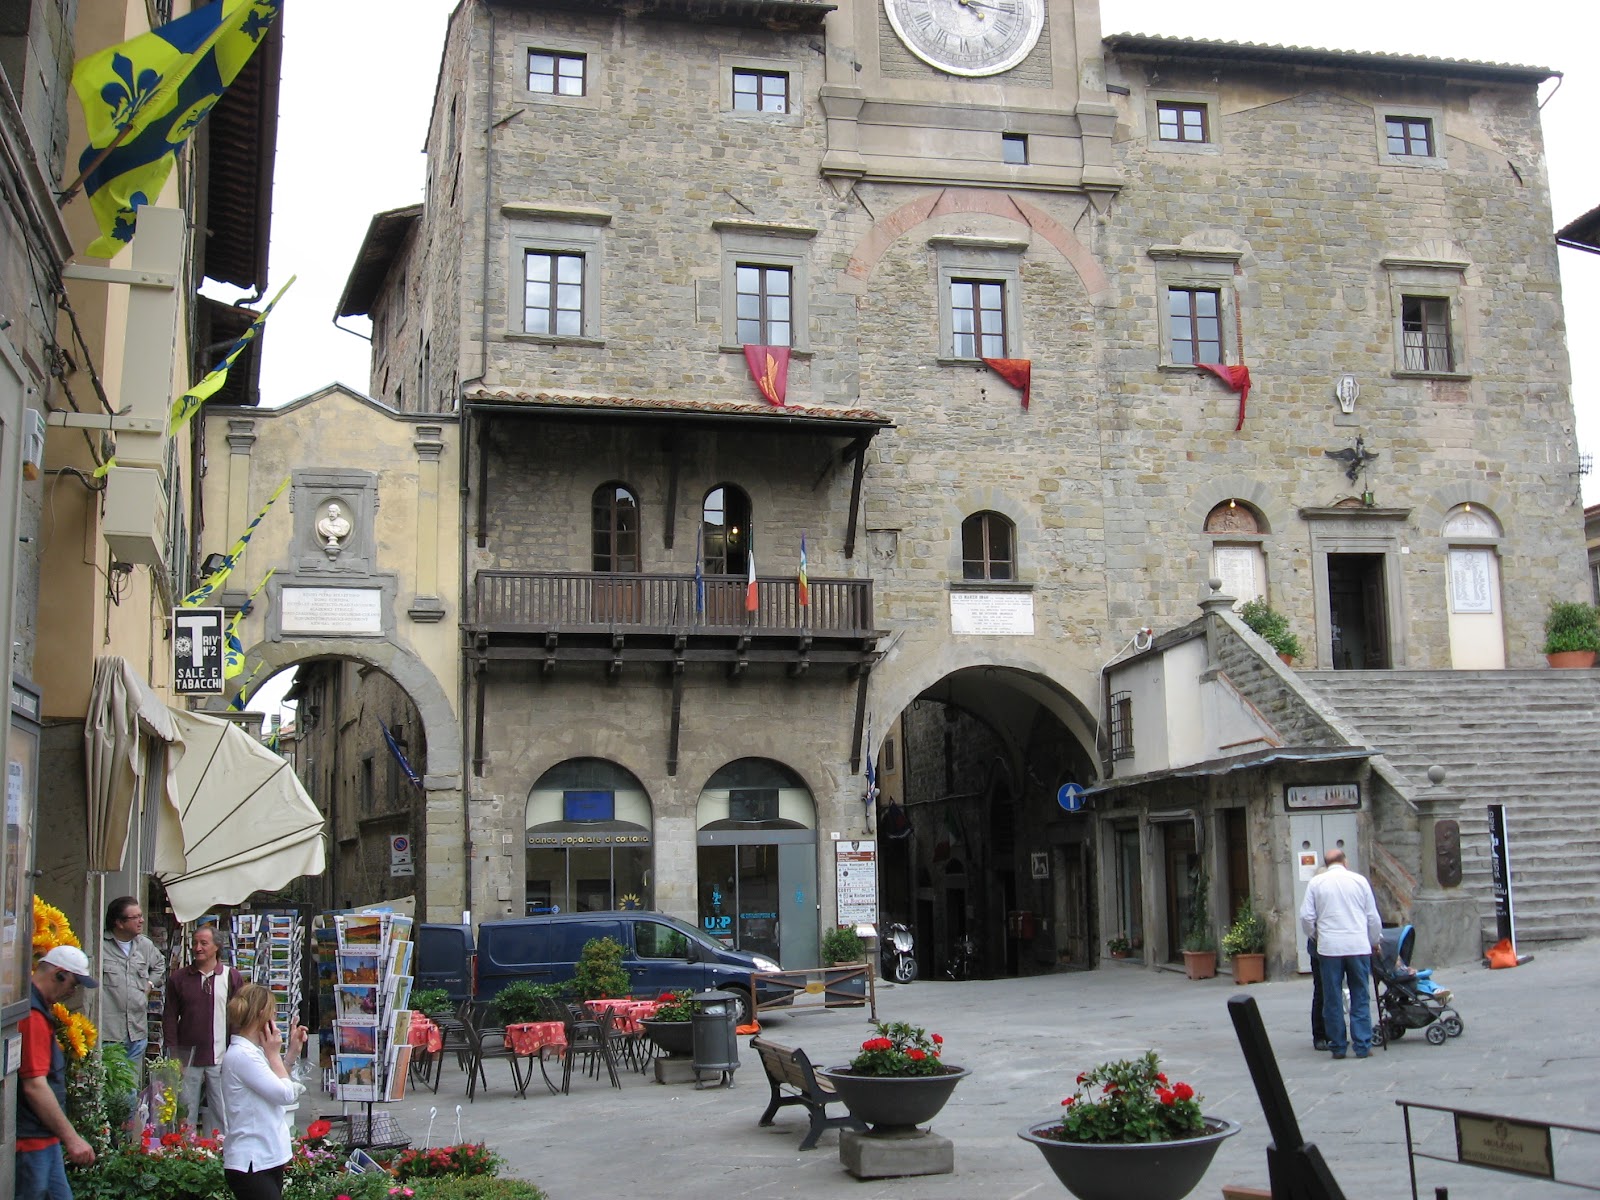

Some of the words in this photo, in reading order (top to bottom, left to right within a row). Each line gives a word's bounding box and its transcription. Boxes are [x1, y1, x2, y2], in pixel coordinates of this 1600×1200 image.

[177, 616, 217, 667] T
[178, 668, 206, 679] SALE
[211, 667, 218, 678] E
[176, 679, 222, 690] TABACCHI
[528, 835, 558, 844] banca
[561, 835, 602, 846] popolare
[604, 835, 613, 843] di
[615, 834, 649, 843] cortona
[704, 916, 732, 929] URP
